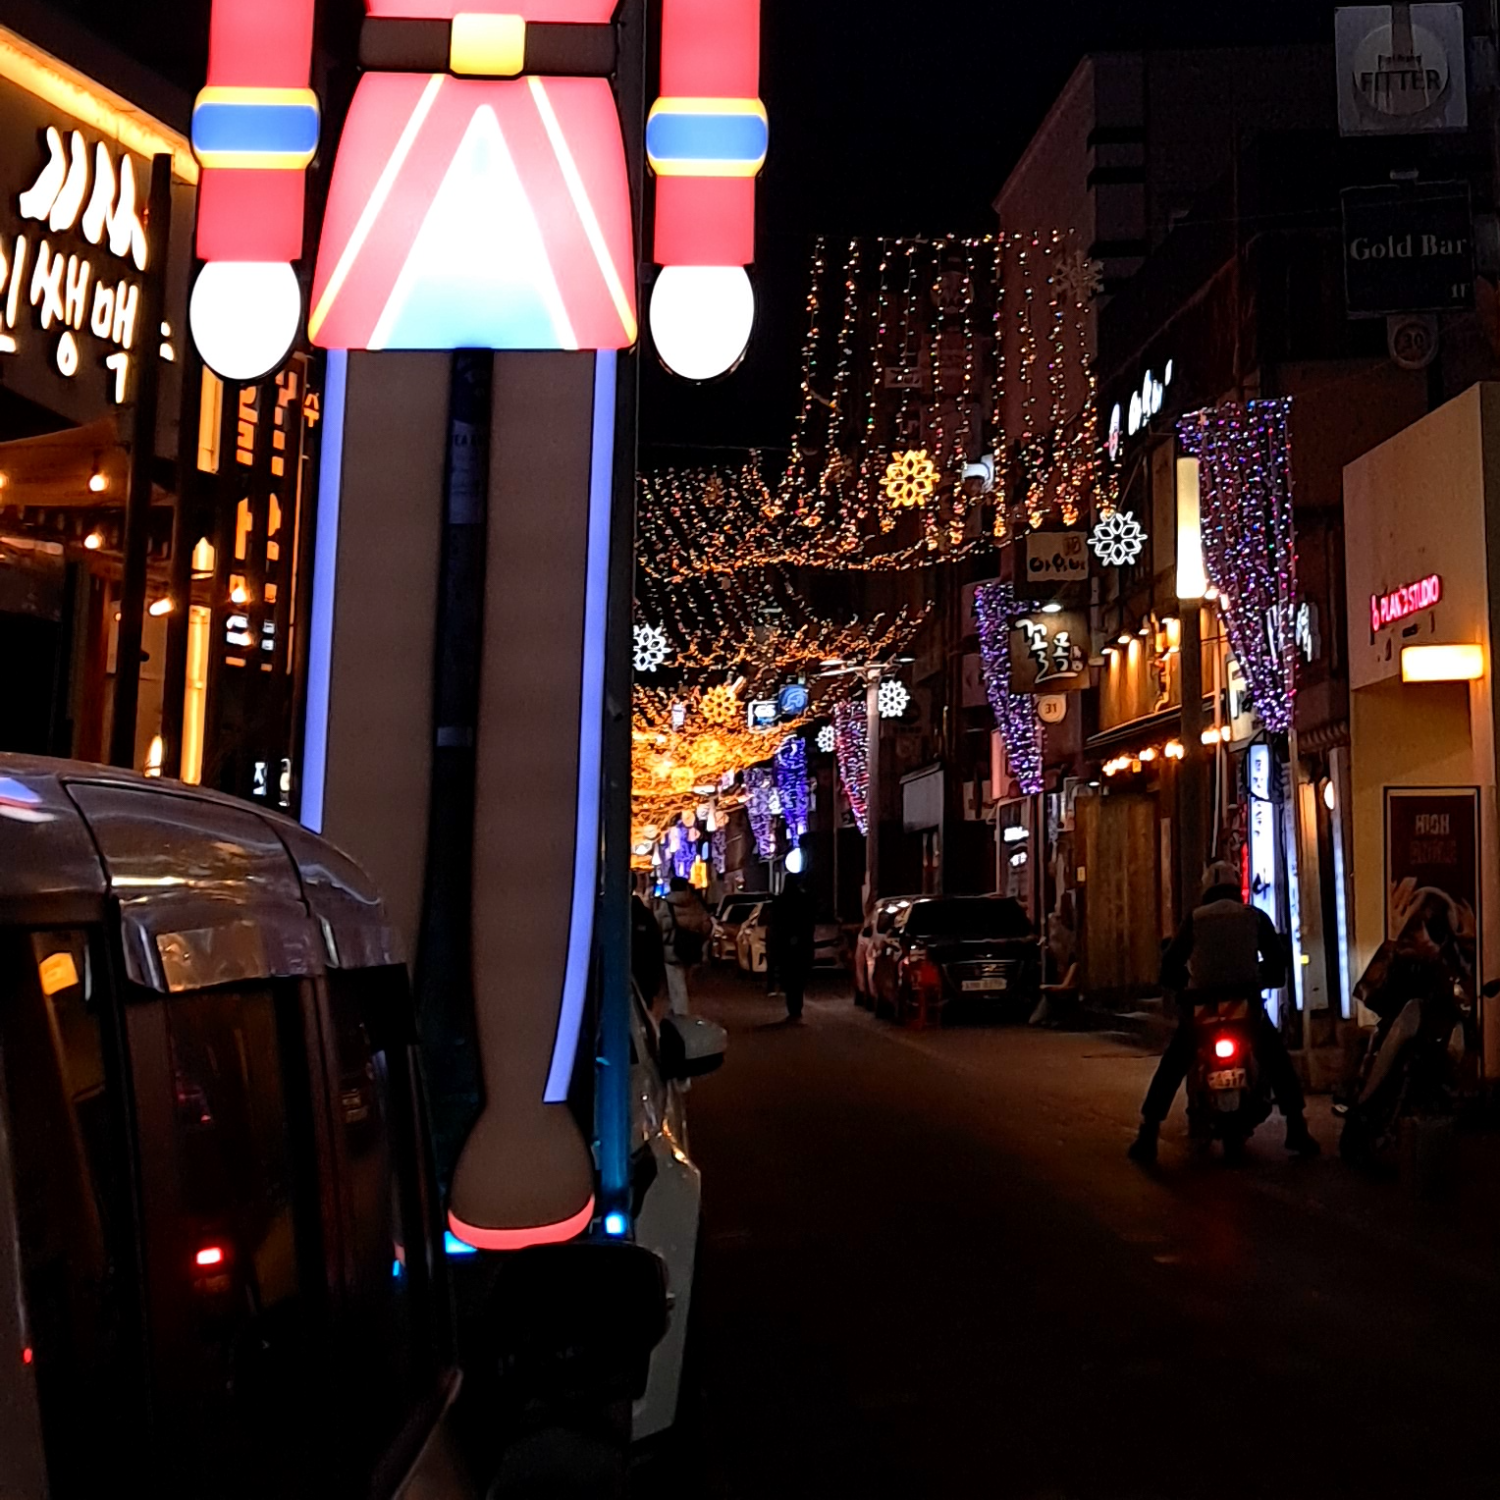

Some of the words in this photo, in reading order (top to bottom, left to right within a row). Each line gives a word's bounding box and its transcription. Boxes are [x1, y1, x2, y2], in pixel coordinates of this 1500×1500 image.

[1360, 69, 1441, 92] FITTER
[1350, 234, 1413, 261] Gold
[1420, 234, 1468, 257] Bar
